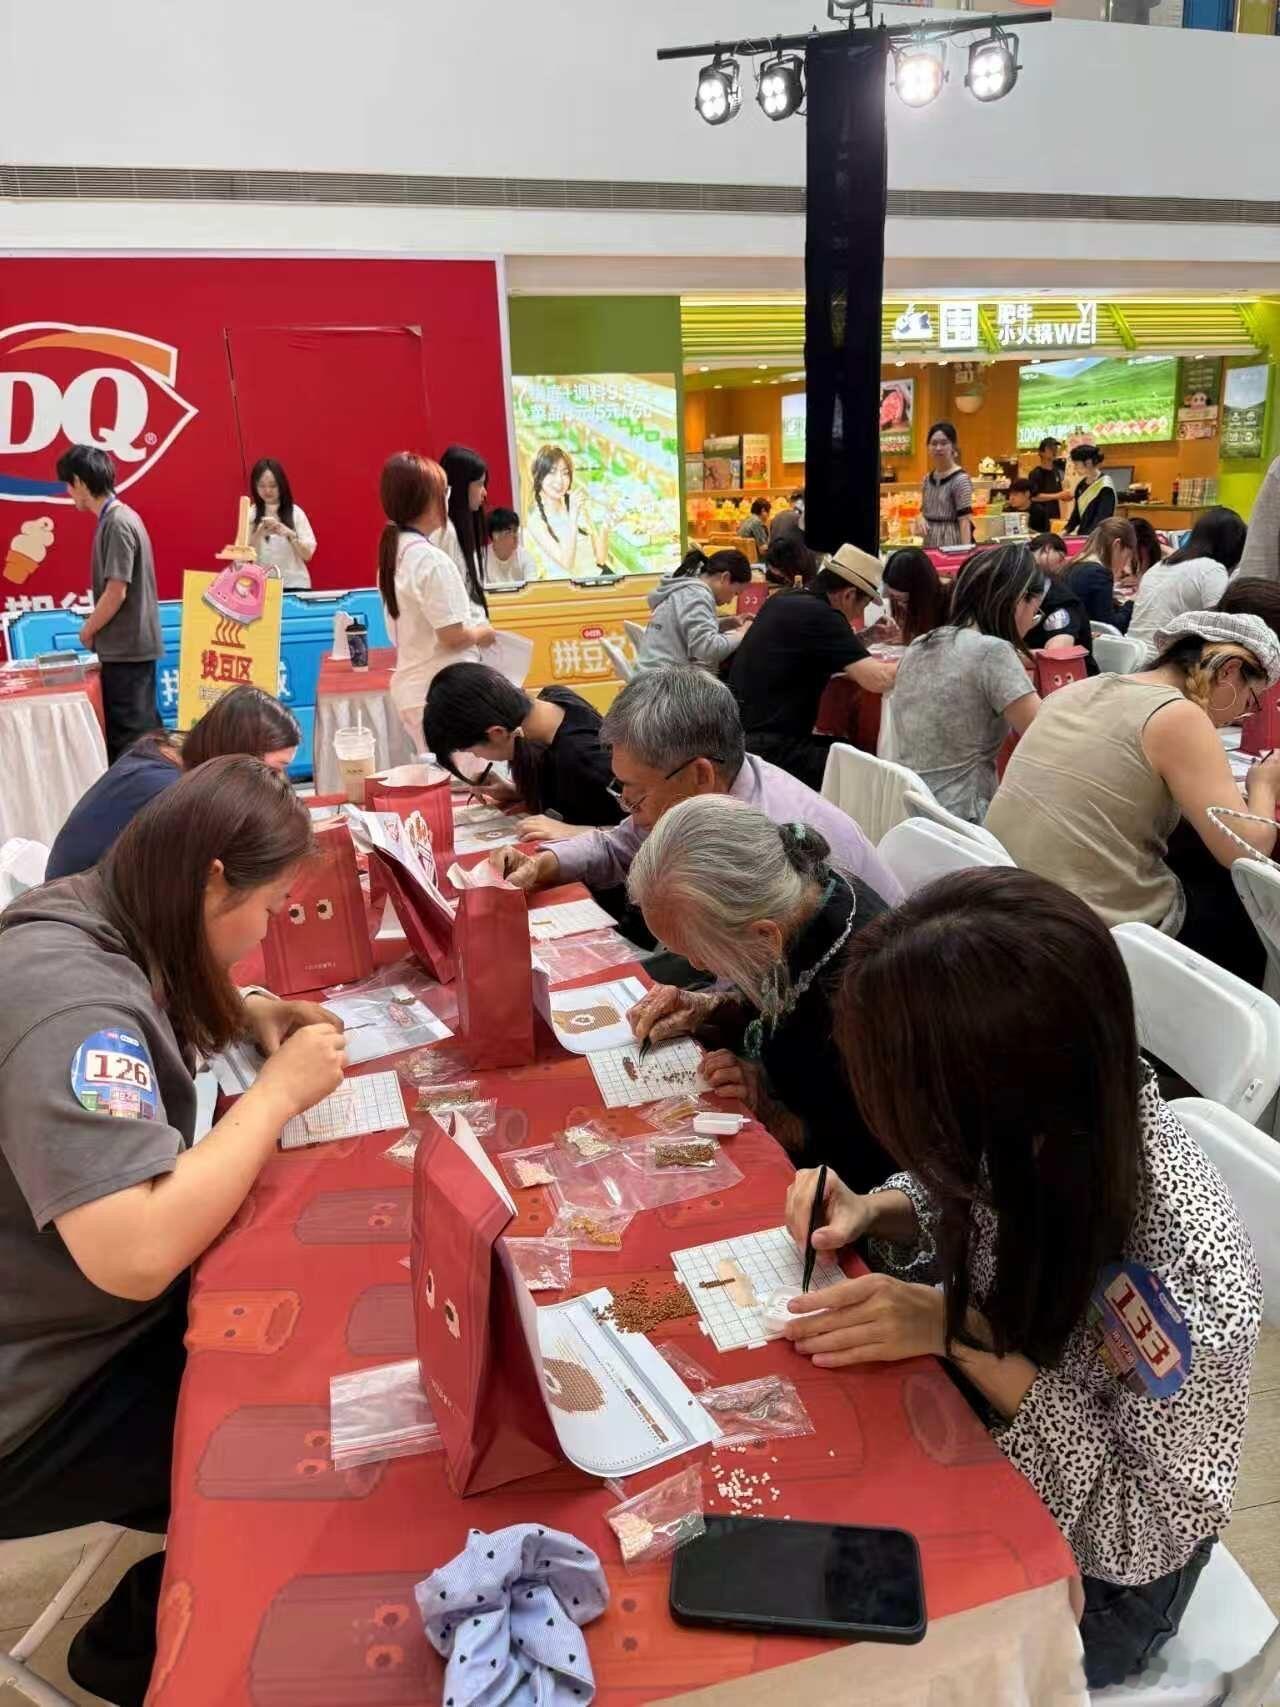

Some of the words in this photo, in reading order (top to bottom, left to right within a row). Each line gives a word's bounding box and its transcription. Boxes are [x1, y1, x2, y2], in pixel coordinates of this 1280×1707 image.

[201, 649, 253, 684] 烫豆区
[94, 1054, 147, 1086] 126
[1111, 1282, 1170, 1365] 133
